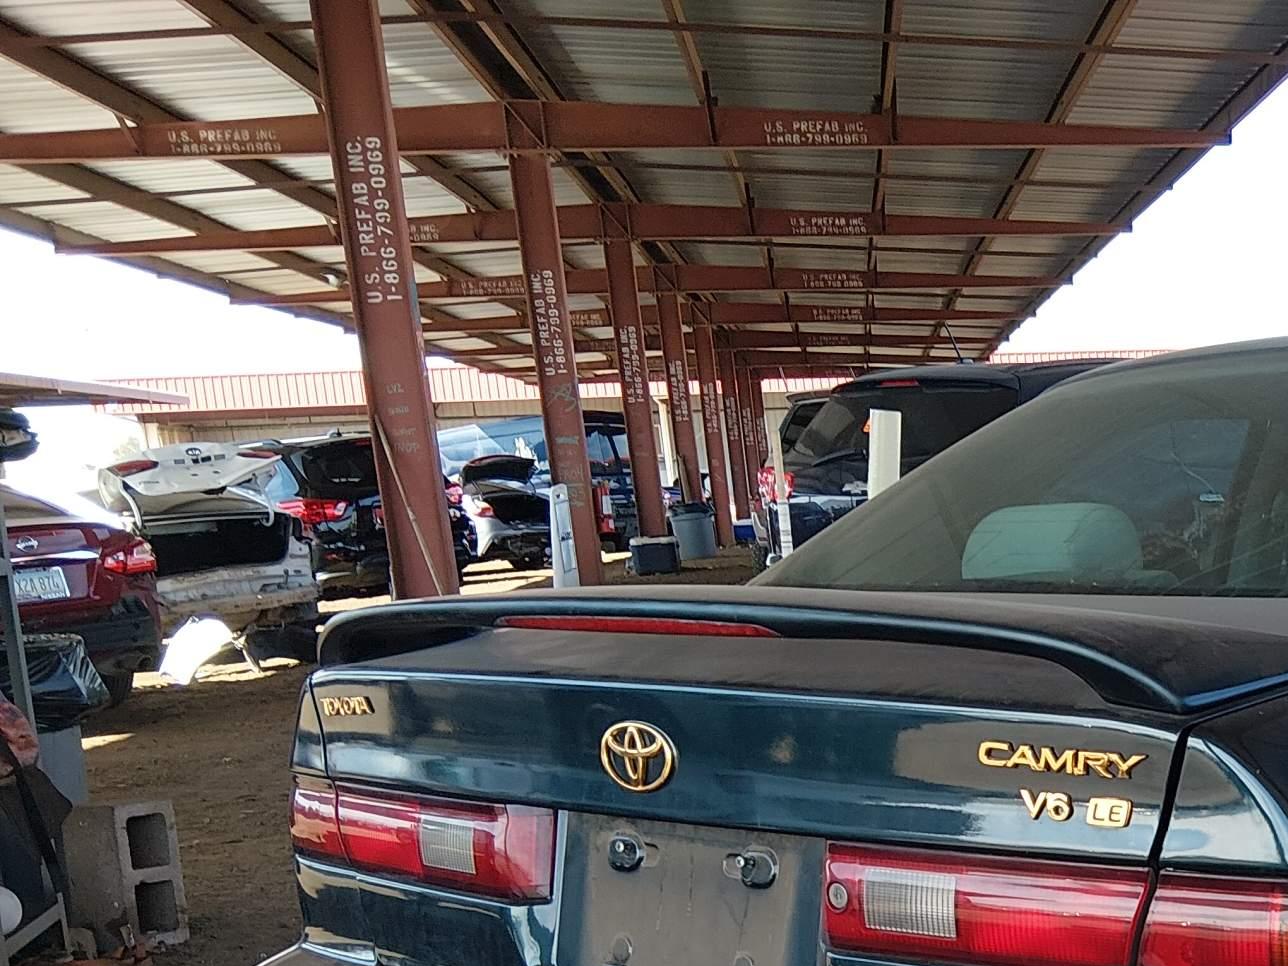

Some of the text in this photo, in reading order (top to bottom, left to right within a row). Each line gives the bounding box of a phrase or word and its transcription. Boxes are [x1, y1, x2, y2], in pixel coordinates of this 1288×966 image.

[167, 130, 194, 143] U.S.
[199, 129, 250, 142] PREFAB
[764, 121, 868, 133] U.S. PREFAB INC.
[346, 135, 383, 303] U.S. PREFAB INC.
[365, 136, 403, 300] 1-866-799-0969
[531, 270, 556, 376] U.S. PREFAB INC.
[542, 270, 568, 374] 1-866-799-0969
[320, 695, 373, 716] TOYOTA
[978, 740, 1149, 779] CAMRY
[1020, 789, 1124, 823] V6 LE
